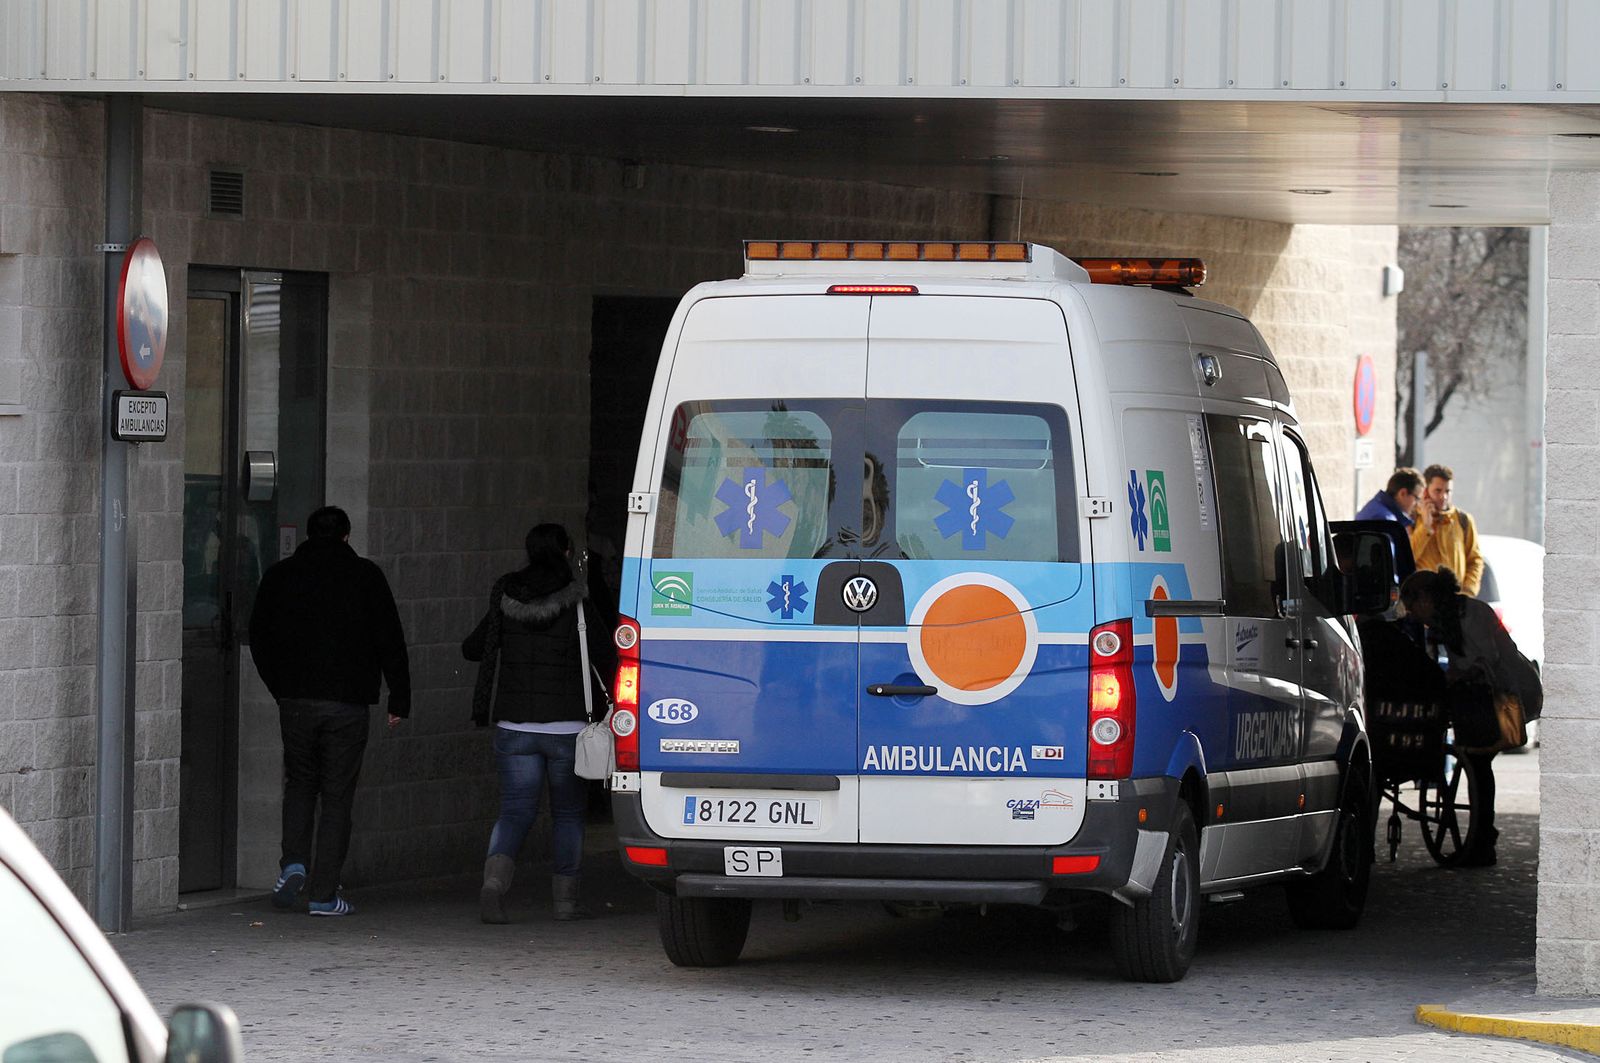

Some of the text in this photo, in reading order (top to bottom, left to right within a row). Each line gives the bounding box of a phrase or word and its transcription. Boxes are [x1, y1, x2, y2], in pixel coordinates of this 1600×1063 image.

[128, 400, 157, 414] EXCEPTO
[121, 418, 165, 432] AMBULANCIAS
[743, 595, 762, 603] SALUD
[655, 702, 693, 721] 168
[1235, 710, 1295, 761] URGENCIAS
[662, 740, 738, 752] CRAFTER
[1033, 747, 1062, 759] TDI
[862, 745, 1028, 772] AMBULANCIA
[1006, 799, 1041, 810] GAZA
[699, 800, 757, 823] 8122
[769, 801, 814, 825] GNL
